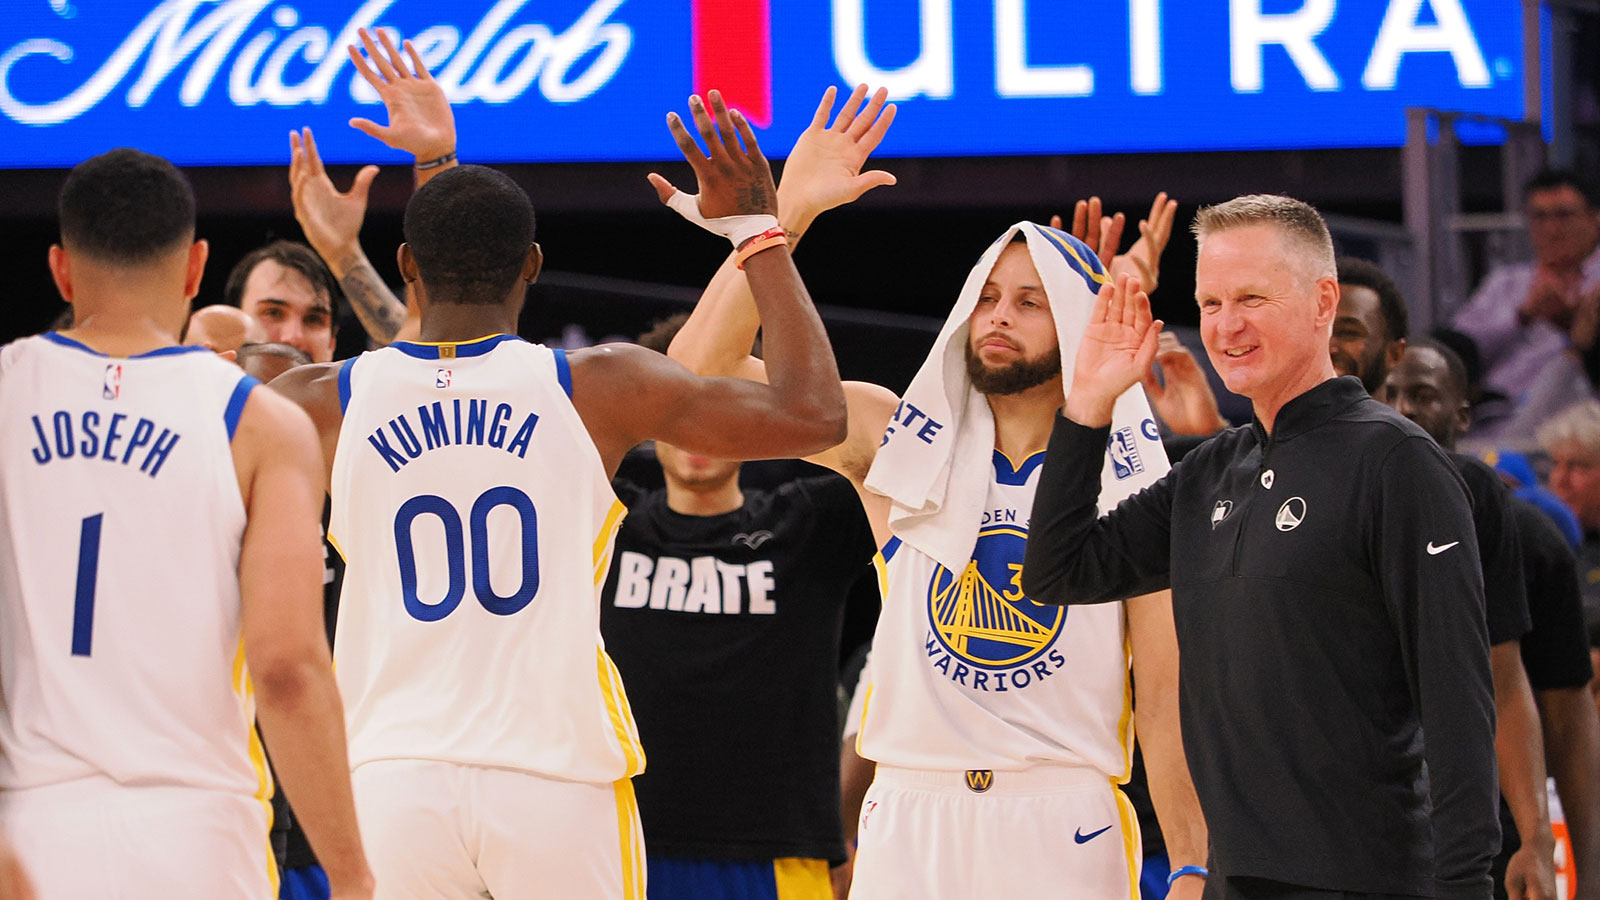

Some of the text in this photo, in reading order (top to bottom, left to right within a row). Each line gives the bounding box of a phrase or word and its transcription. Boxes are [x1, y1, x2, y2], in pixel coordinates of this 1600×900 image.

[0, 0, 632, 124] Michelob
[31, 410, 180, 478] JOSEPH
[367, 398, 540, 473] KUMINGA
[71, 512, 103, 657] 1
[393, 485, 540, 622] 00
[613, 551, 776, 614] BRATE
[925, 631, 1065, 692] WARRIORS
